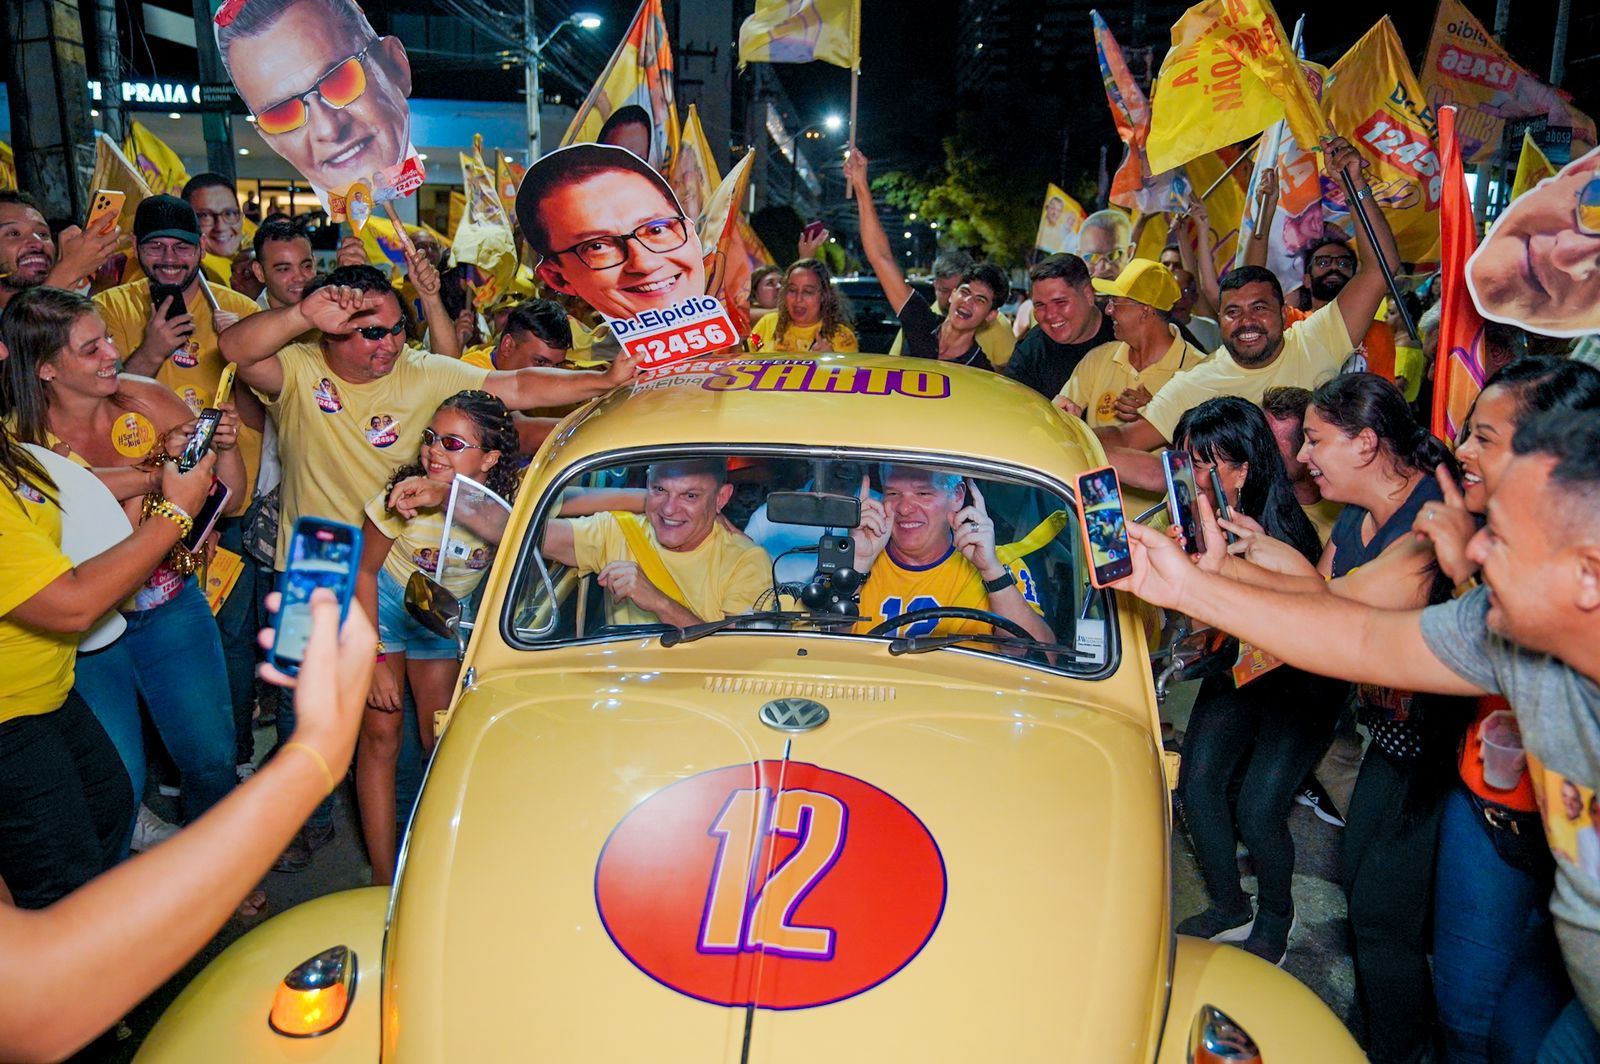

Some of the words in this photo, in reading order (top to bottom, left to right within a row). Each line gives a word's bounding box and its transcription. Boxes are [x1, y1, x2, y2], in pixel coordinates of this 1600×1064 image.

[121, 81, 188, 103] PRAIA
[1545, 128, 1571, 144] abosa
[1363, 121, 1440, 203] 12456
[635, 323, 727, 364] 12456
[704, 363, 950, 399] SARTO
[1304, 789, 1319, 804] ILA
[697, 787, 849, 960] 12
